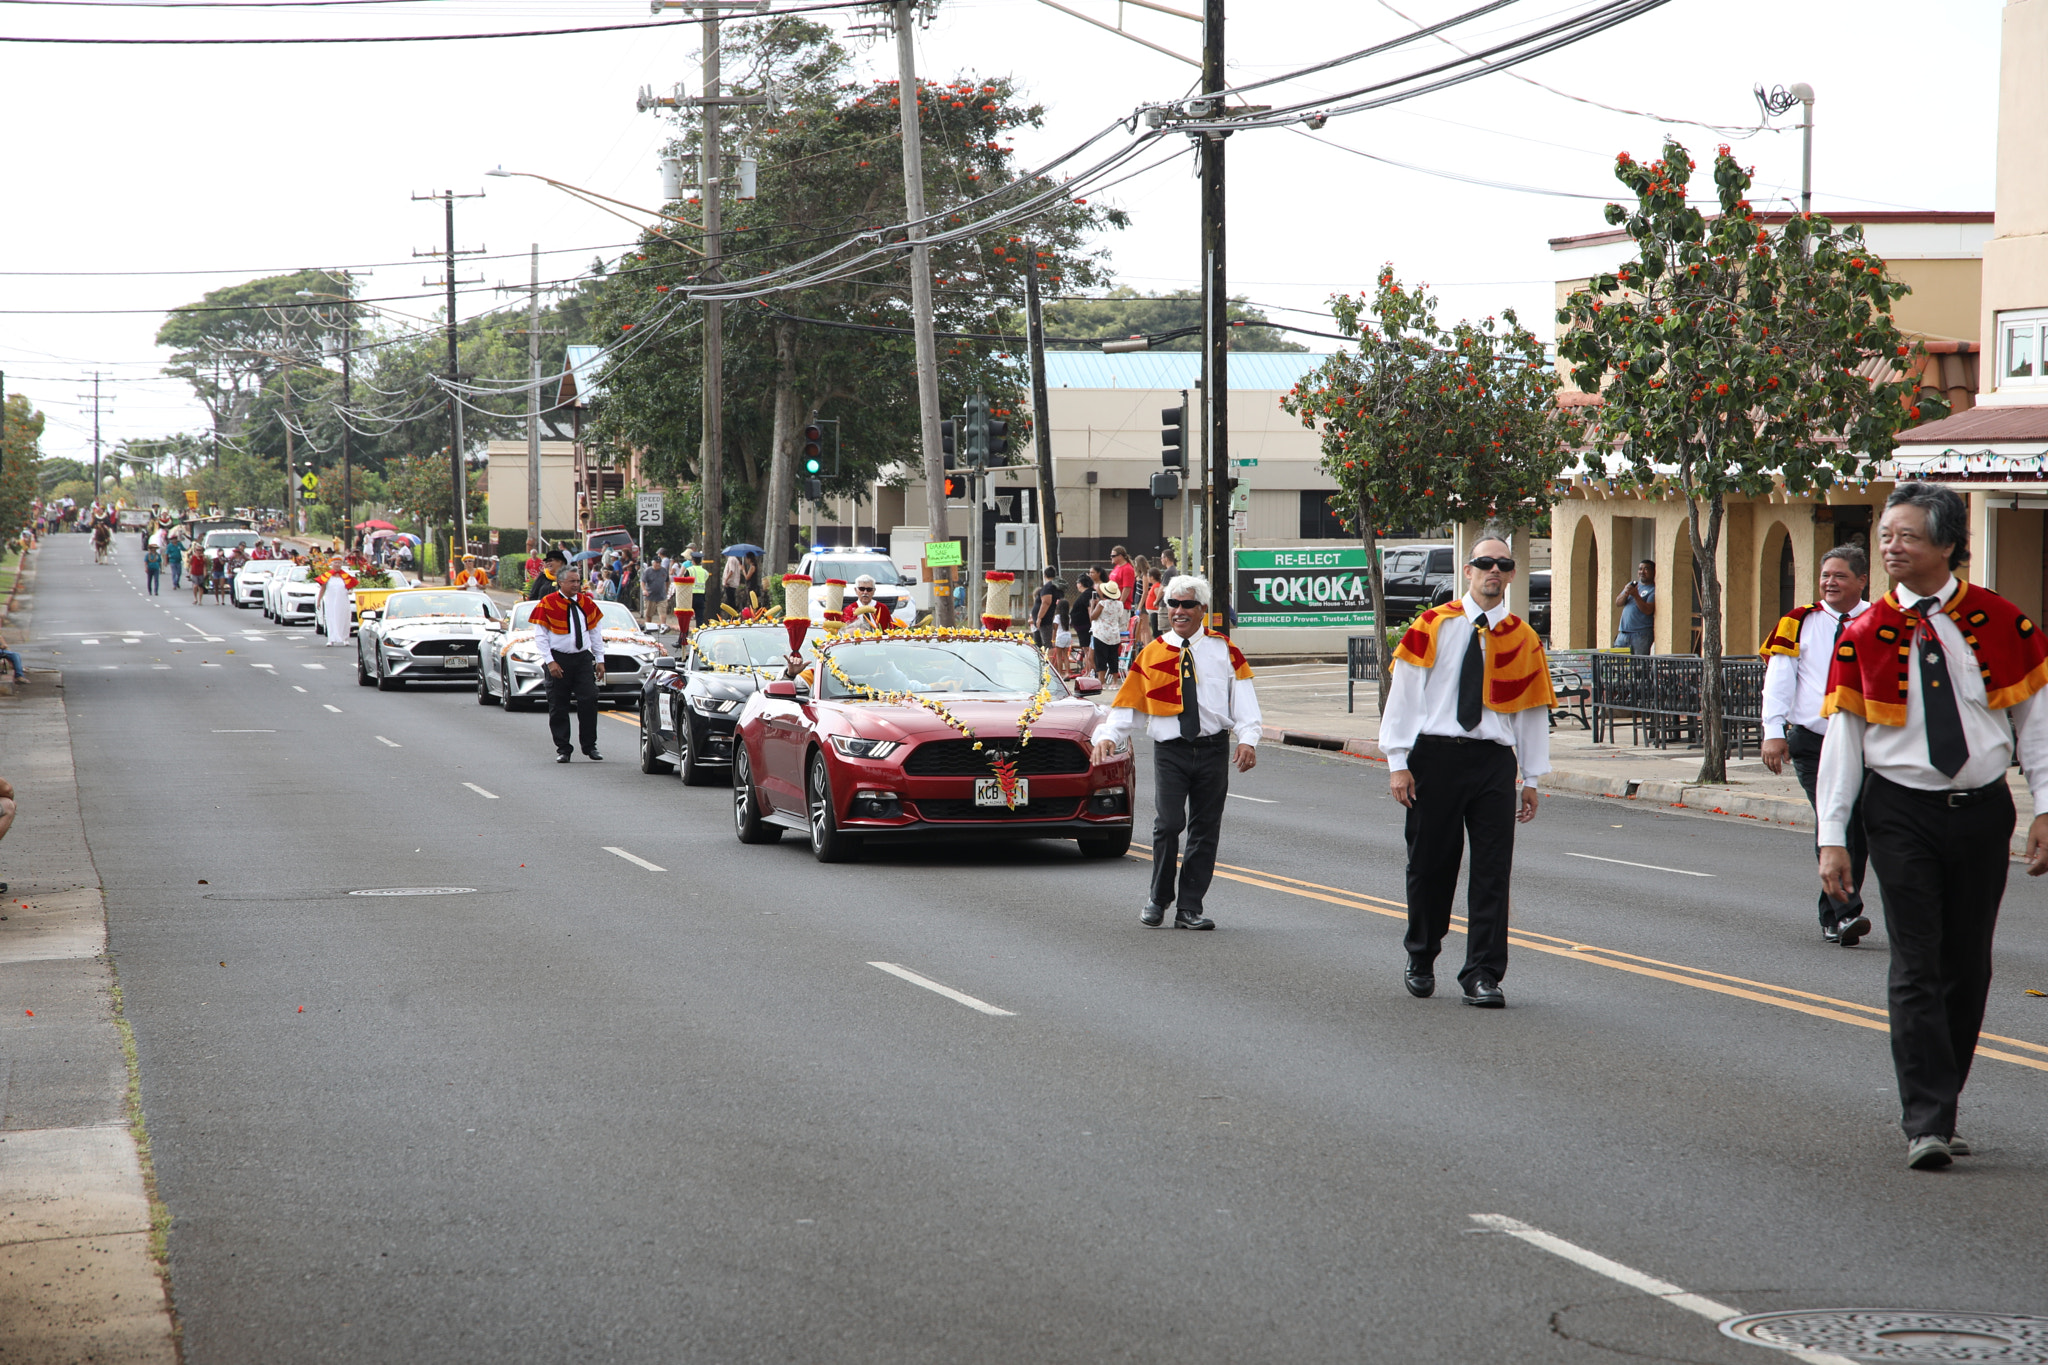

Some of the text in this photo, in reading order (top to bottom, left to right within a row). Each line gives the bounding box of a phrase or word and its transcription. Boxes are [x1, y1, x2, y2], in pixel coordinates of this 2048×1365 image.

[640, 510, 660, 521] 25
[1275, 553, 1341, 566] RE-ELECT
[1254, 576, 1365, 602] TOKIOKA
[1237, 615, 1291, 623] EXPERIENCED
[1293, 615, 1321, 623] Proven.
[1322, 614, 1352, 623] Trusted.
[978, 785, 999, 800] KCB
